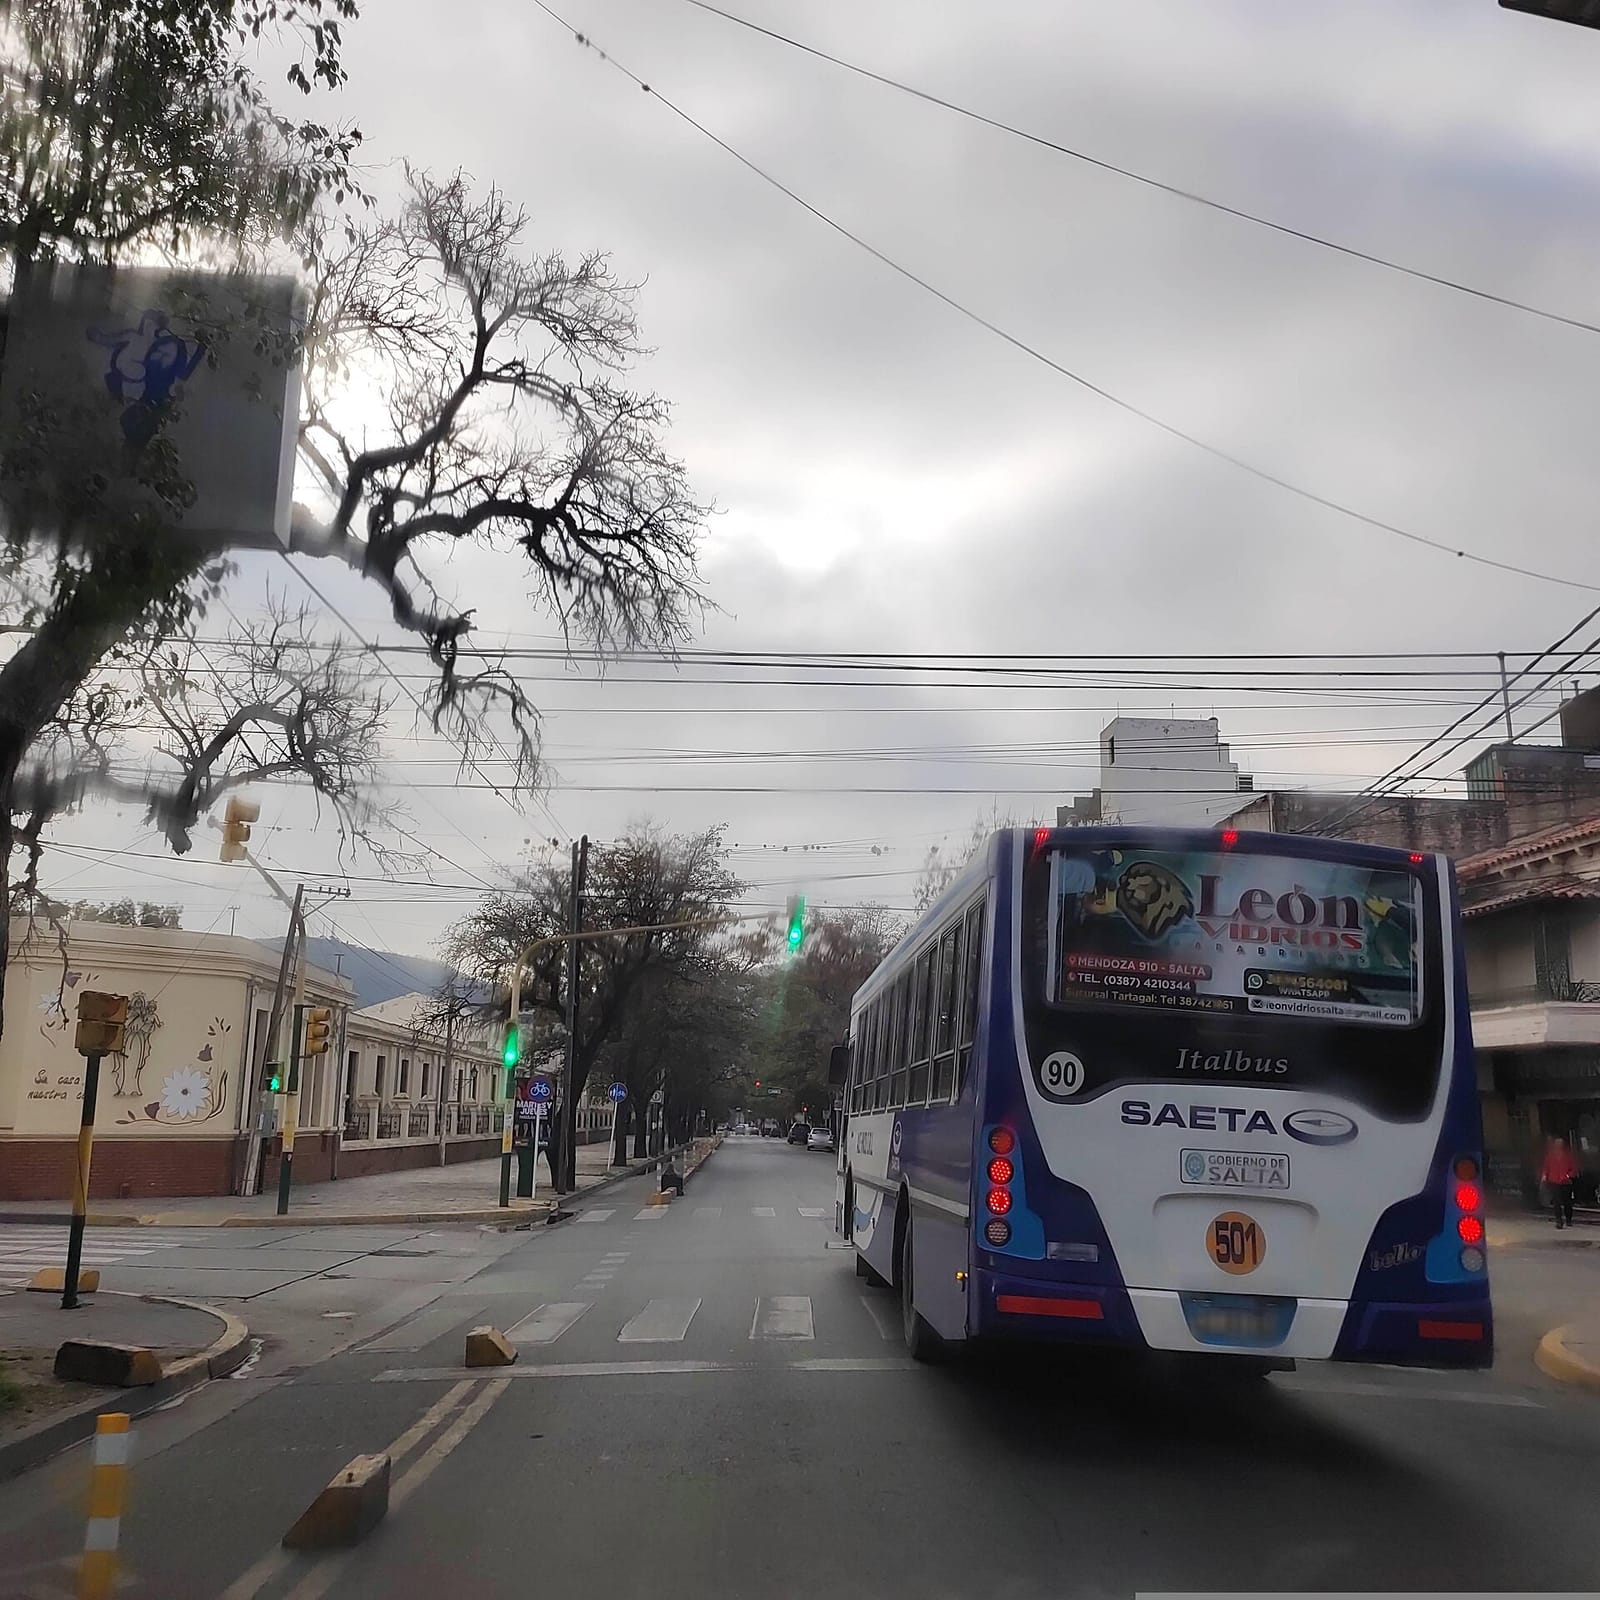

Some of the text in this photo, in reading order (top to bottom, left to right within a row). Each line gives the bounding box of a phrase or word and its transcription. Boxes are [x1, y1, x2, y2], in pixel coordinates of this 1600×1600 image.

[1196, 874, 1363, 930] León
[1197, 920, 1363, 949] VIDRIOS
[1078, 957, 1136, 971] MENDOZA
[1139, 961, 1158, 971] 910
[1169, 963, 1206, 976] SALTA
[1077, 972, 1191, 990] TEL. (0387) 4210344
[1112, 992, 1158, 1004] Tartagal:
[1160, 995, 1176, 1006] Tel
[1176, 1048, 1289, 1074] Italbus
[1048, 1060, 1077, 1087] 90
[27, 1089, 68, 1100] nuestra
[1121, 1100, 1279, 1135] SAETA
[1208, 1155, 1285, 1169] GOBIERNO DE
[1208, 1167, 1285, 1185] SALTA
[1215, 1220, 1258, 1266] 501
